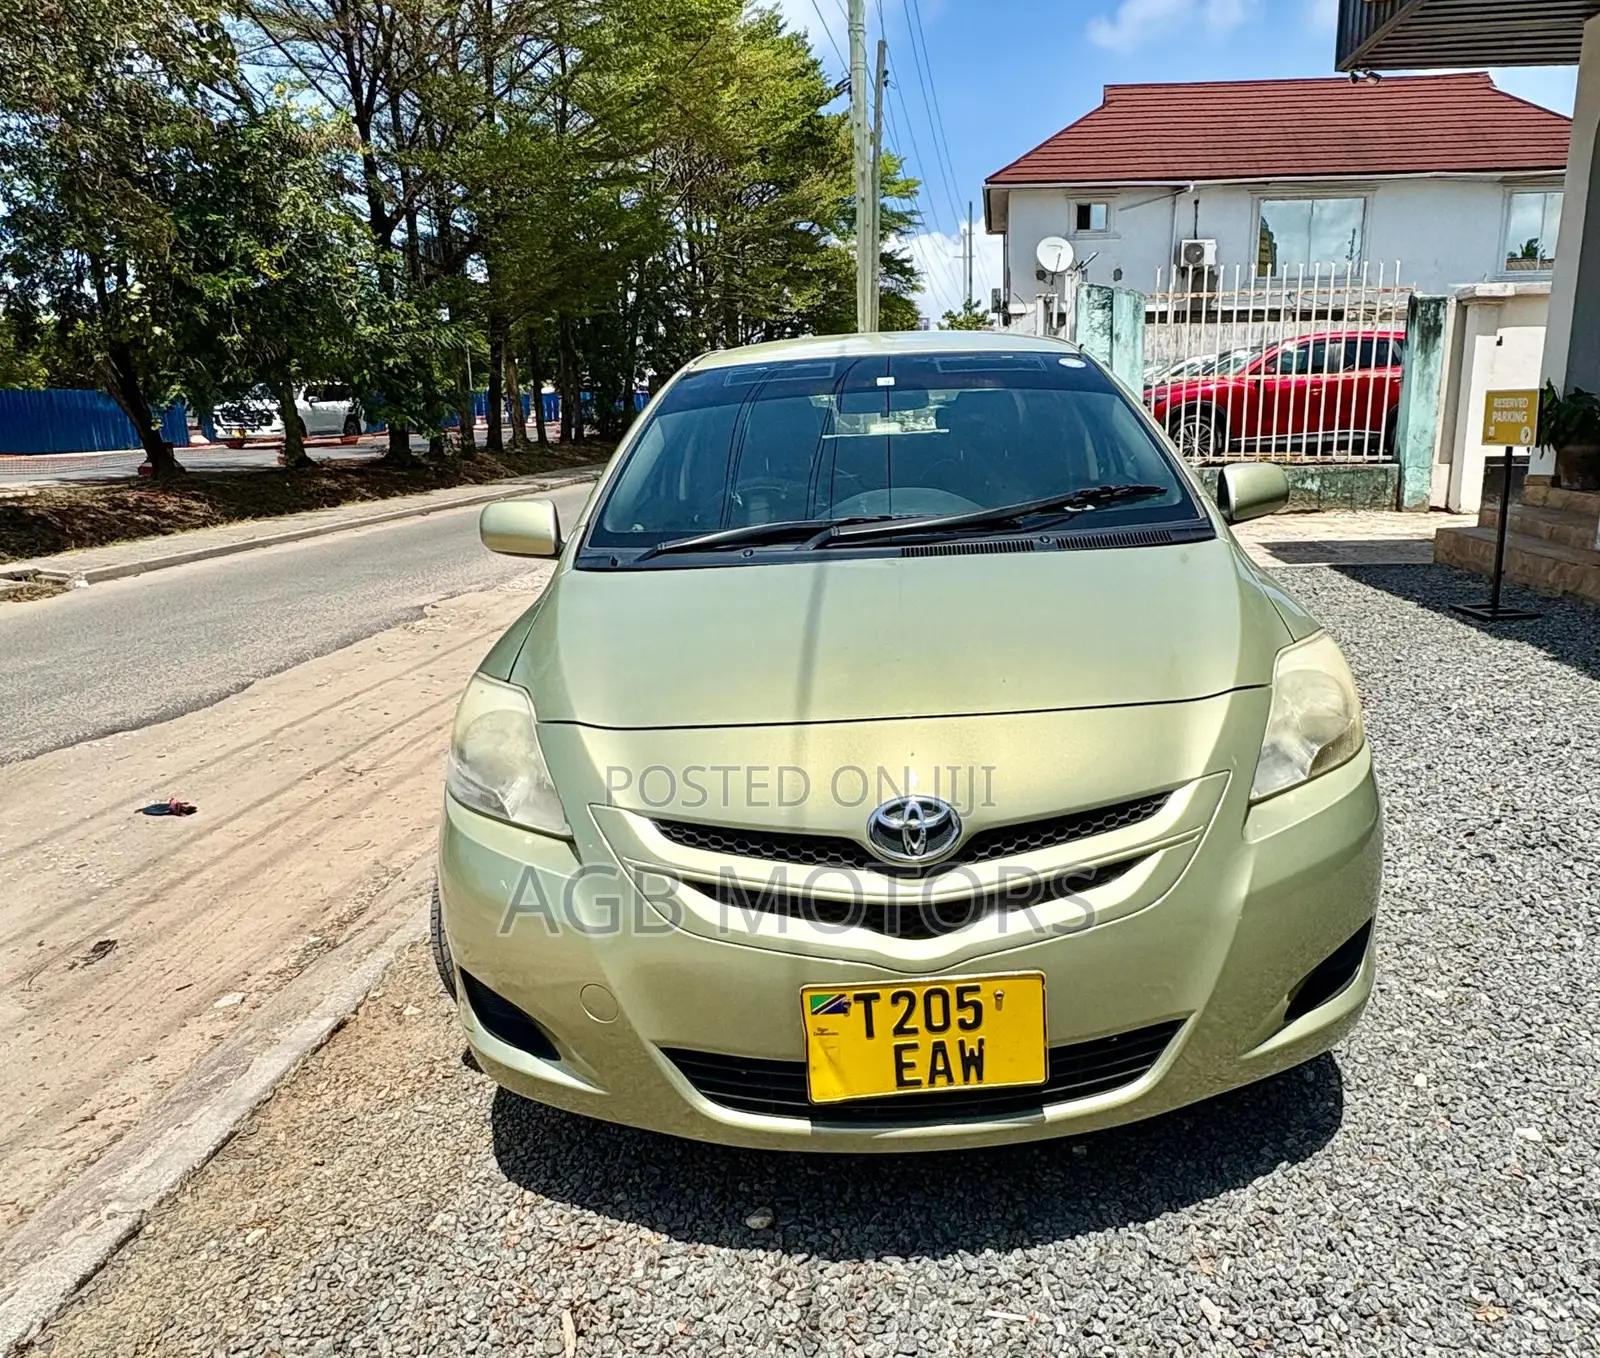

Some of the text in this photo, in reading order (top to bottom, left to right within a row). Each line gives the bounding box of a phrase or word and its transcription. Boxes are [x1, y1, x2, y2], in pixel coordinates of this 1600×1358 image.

[1492, 411, 1528, 423] PARKING
[1493, 397, 1529, 408] RESERVED
[853, 984, 983, 1039] T 205
[893, 1037, 985, 1089] EAW
